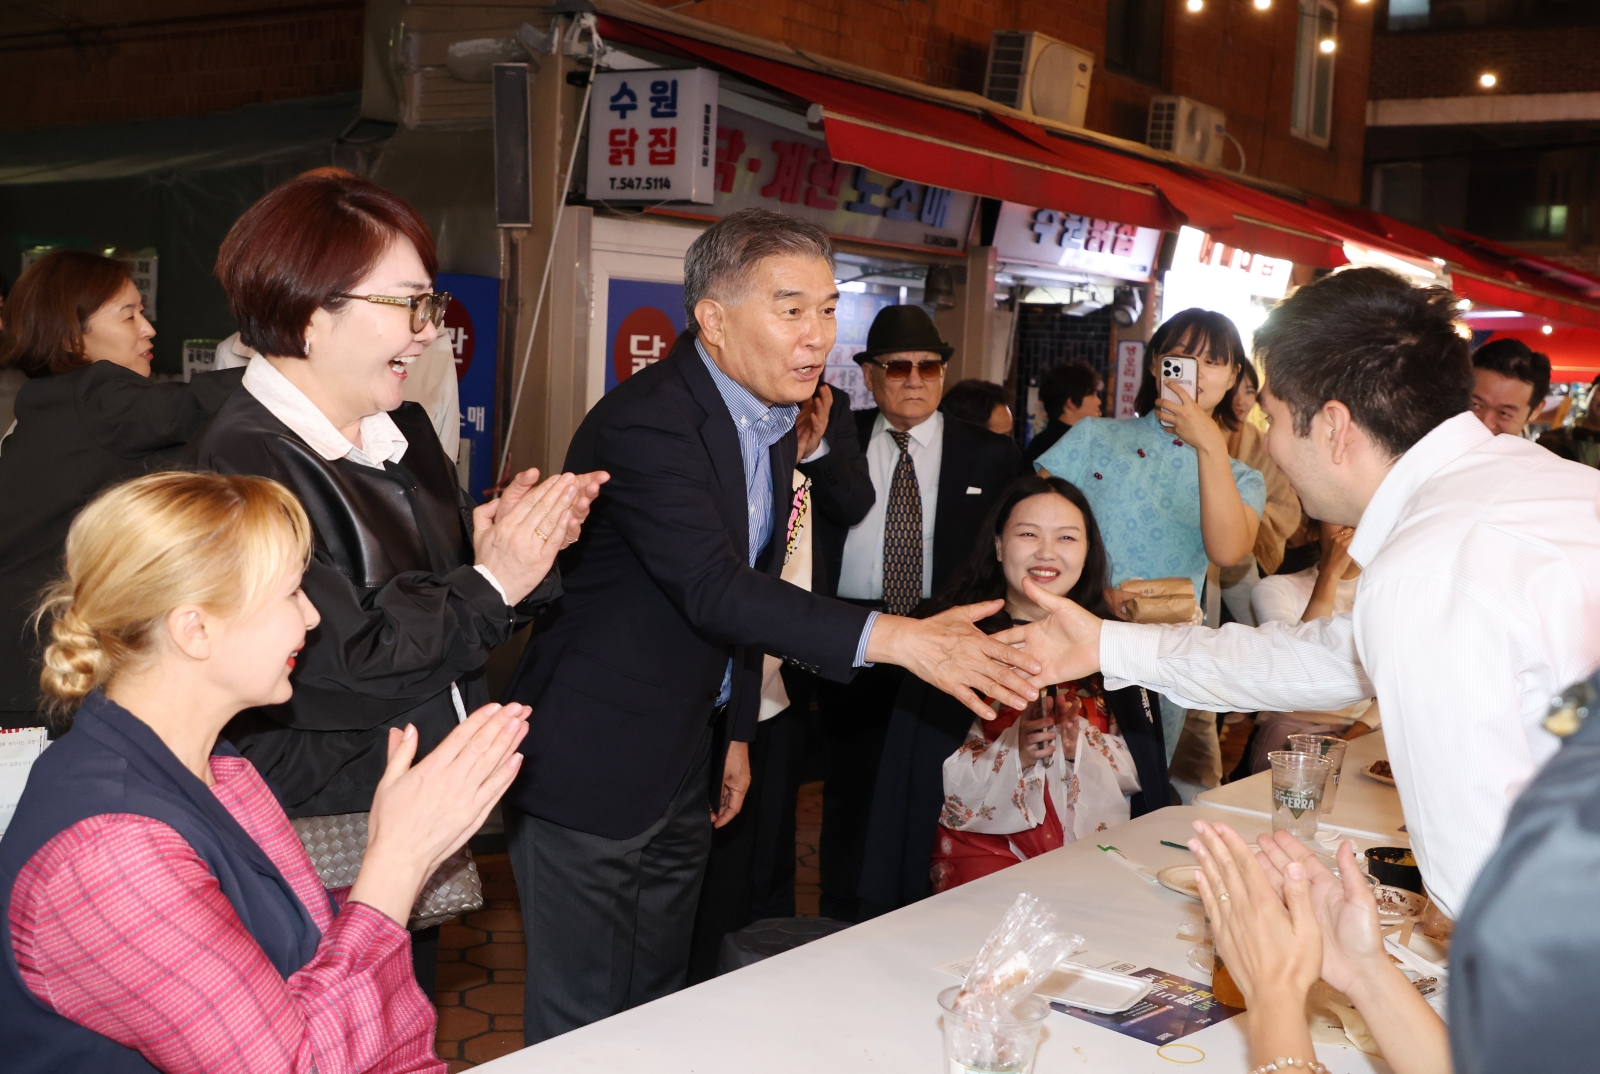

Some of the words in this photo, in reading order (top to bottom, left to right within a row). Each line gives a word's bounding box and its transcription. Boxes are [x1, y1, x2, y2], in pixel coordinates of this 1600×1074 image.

[609, 79, 678, 119] 수원
[608, 127, 677, 166] 닭집
[609, 177, 671, 190] T.547.5114
[1280, 795, 1315, 811] TERRA
